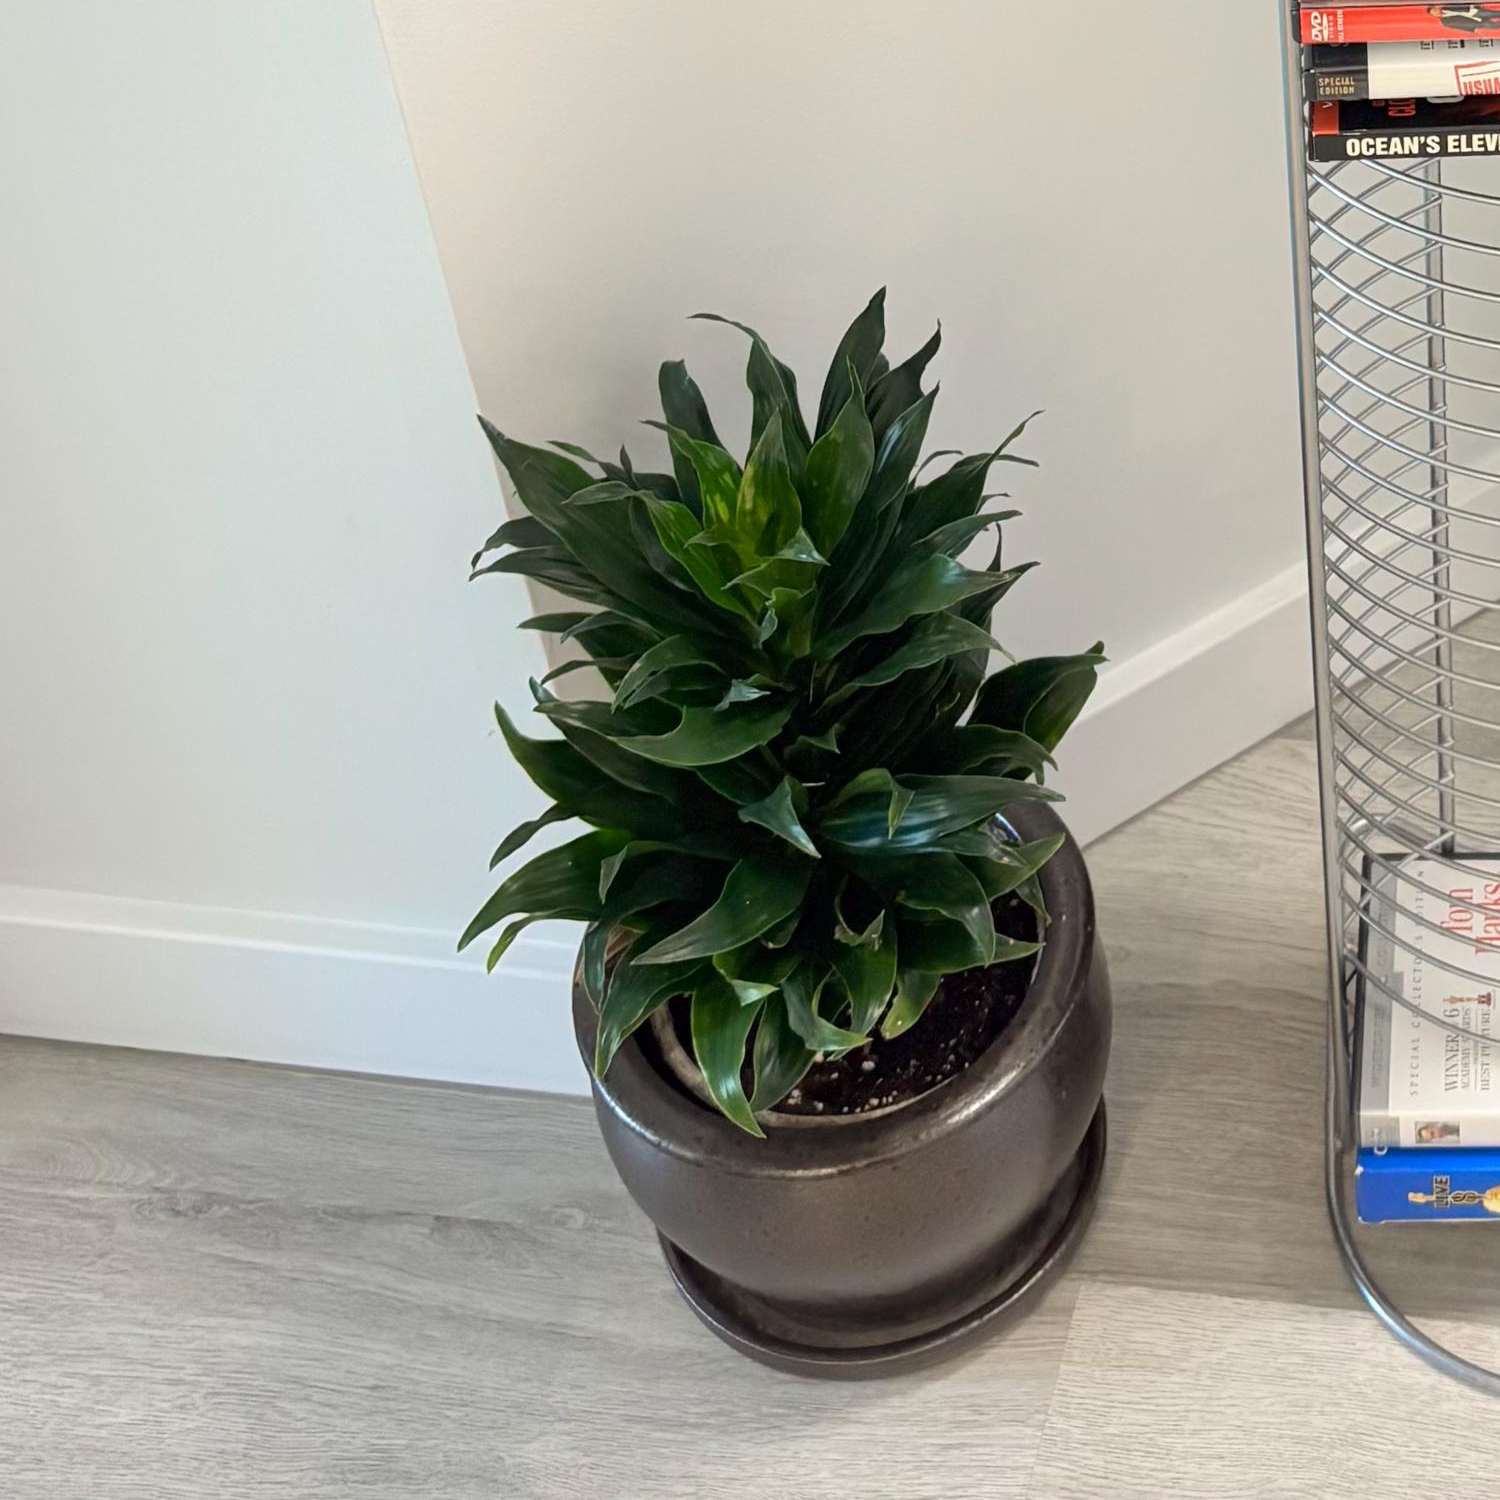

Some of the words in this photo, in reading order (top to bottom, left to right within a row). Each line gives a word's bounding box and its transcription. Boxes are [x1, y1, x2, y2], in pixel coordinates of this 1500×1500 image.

[1311, 12, 1322, 42] DVD
[1318, 77, 1355, 87] SPECIAL
[1319, 86, 1355, 95] EDITION
[1346, 137, 1441, 156] OCEAN'S
[1409, 1037, 1422, 1096] SPECIAL
[1444, 1033, 1459, 1092] WINNER
[1480, 1062, 1491, 1092] BEST
[1433, 1175, 1450, 1209] LIVE
